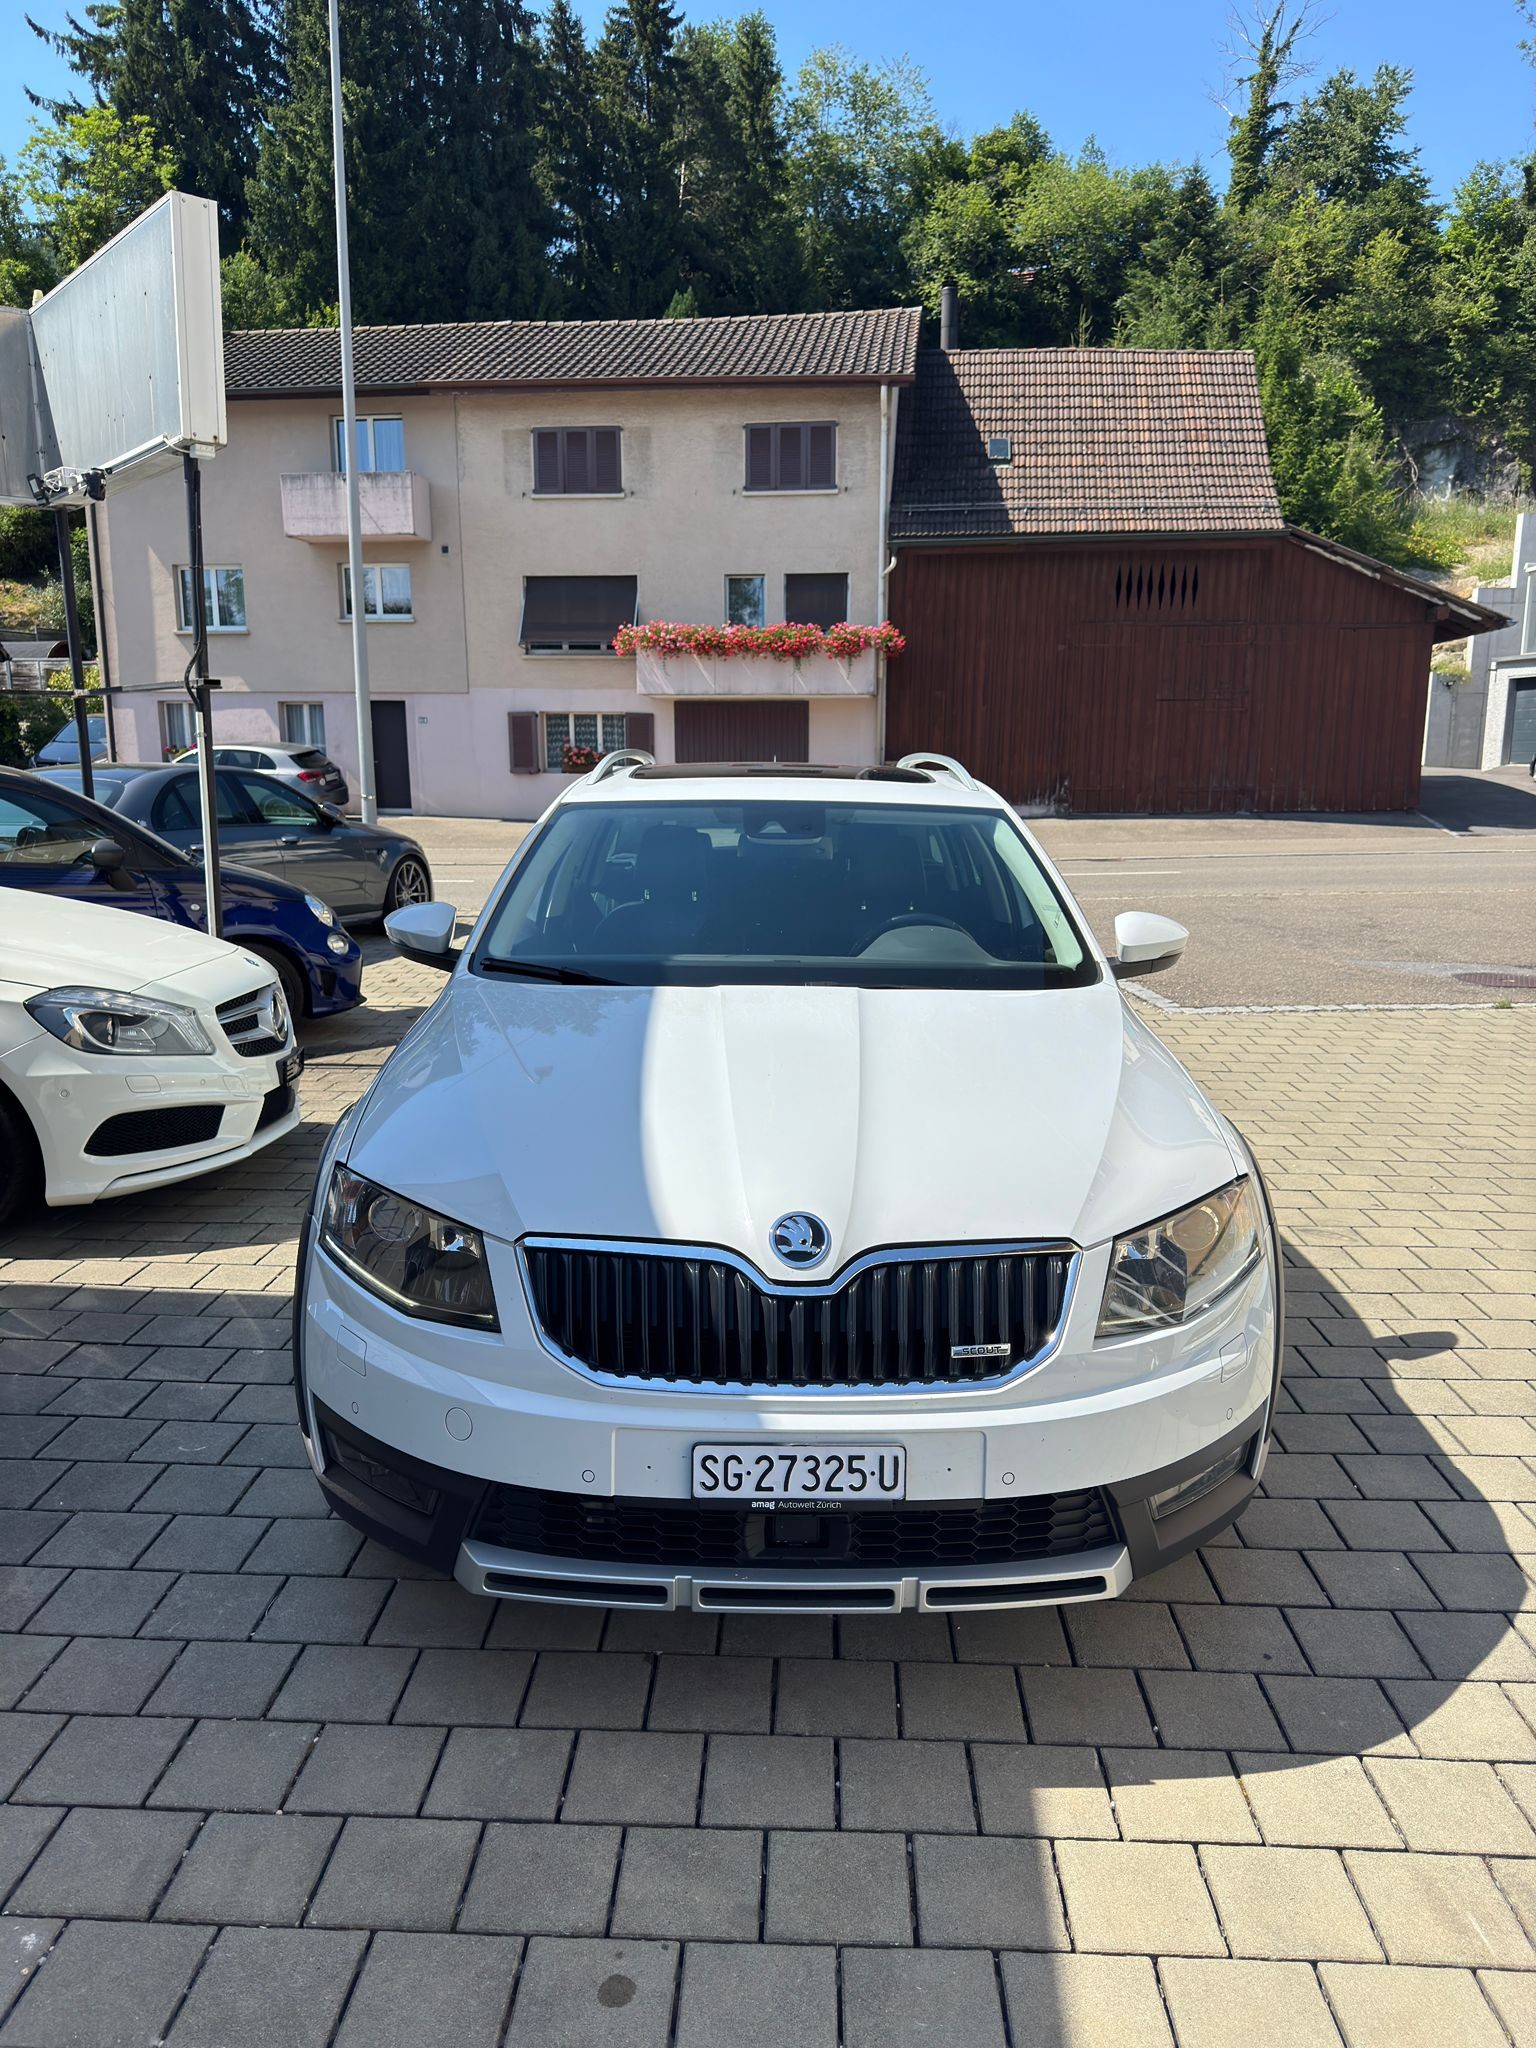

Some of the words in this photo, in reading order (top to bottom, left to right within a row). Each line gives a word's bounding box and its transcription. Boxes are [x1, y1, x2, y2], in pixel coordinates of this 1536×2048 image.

[962, 1346, 1001, 1355] SCOUT
[752, 1501, 775, 1510] amag
[778, 1501, 815, 1509] Autowelt
[816, 1500, 842, 1509] Zürich
